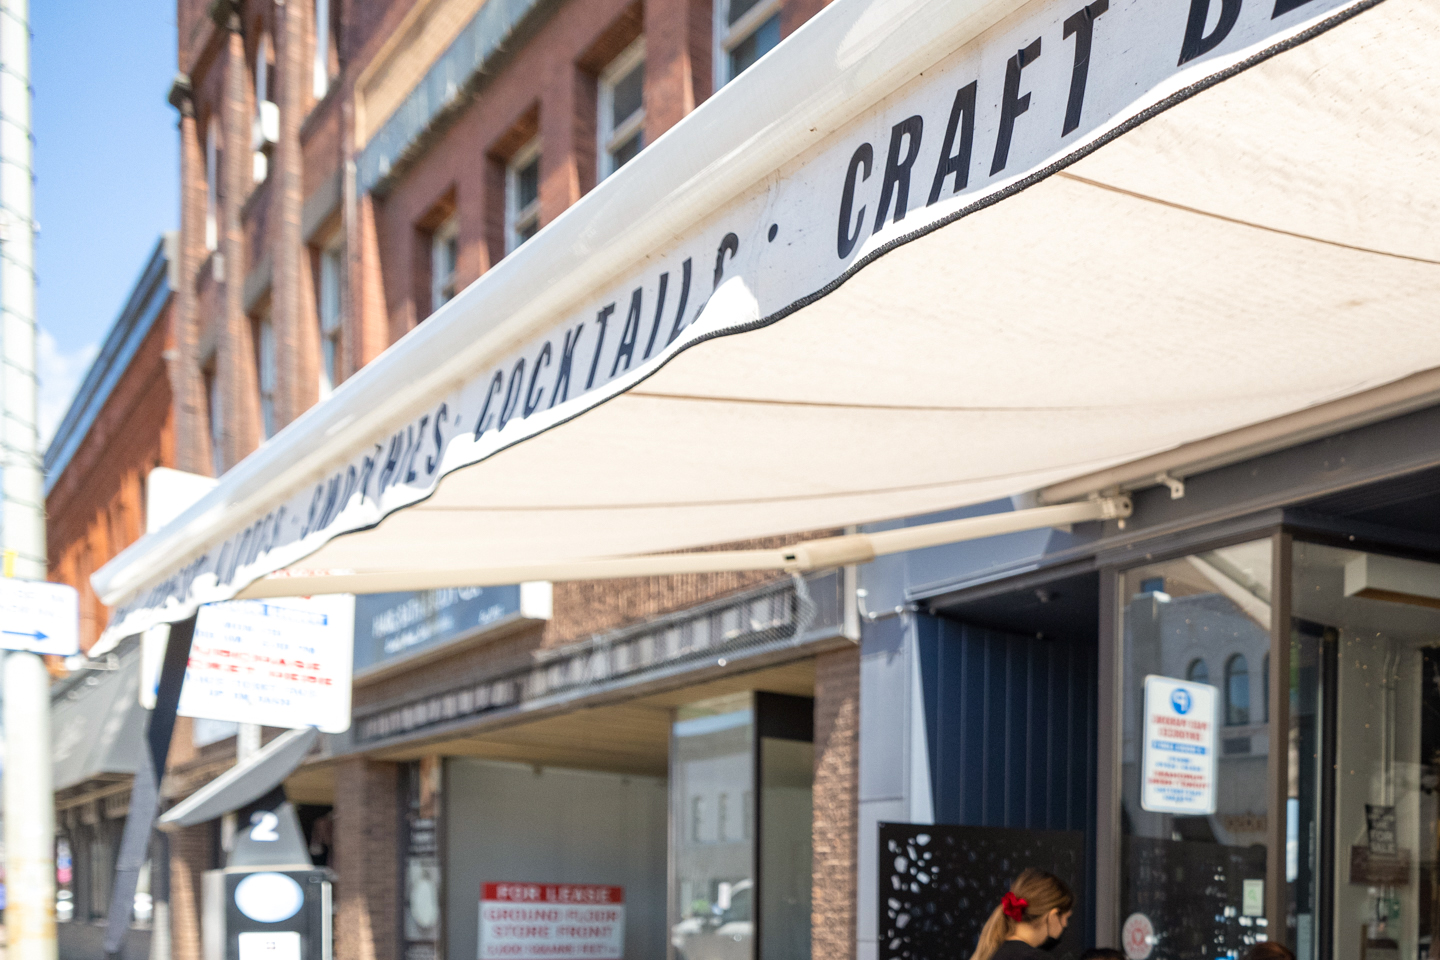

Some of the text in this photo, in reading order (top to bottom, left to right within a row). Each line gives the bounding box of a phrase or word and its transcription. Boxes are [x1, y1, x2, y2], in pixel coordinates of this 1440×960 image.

[474, 231, 739, 442] COCKTAILS
[836, 2, 1109, 260] CRAFT
[250, 811, 279, 841] 2
[496, 884, 612, 903] FOR LEASE
[484, 907, 620, 923] GROUND FLOOR
[492, 923, 613, 939] STORE FRONT
